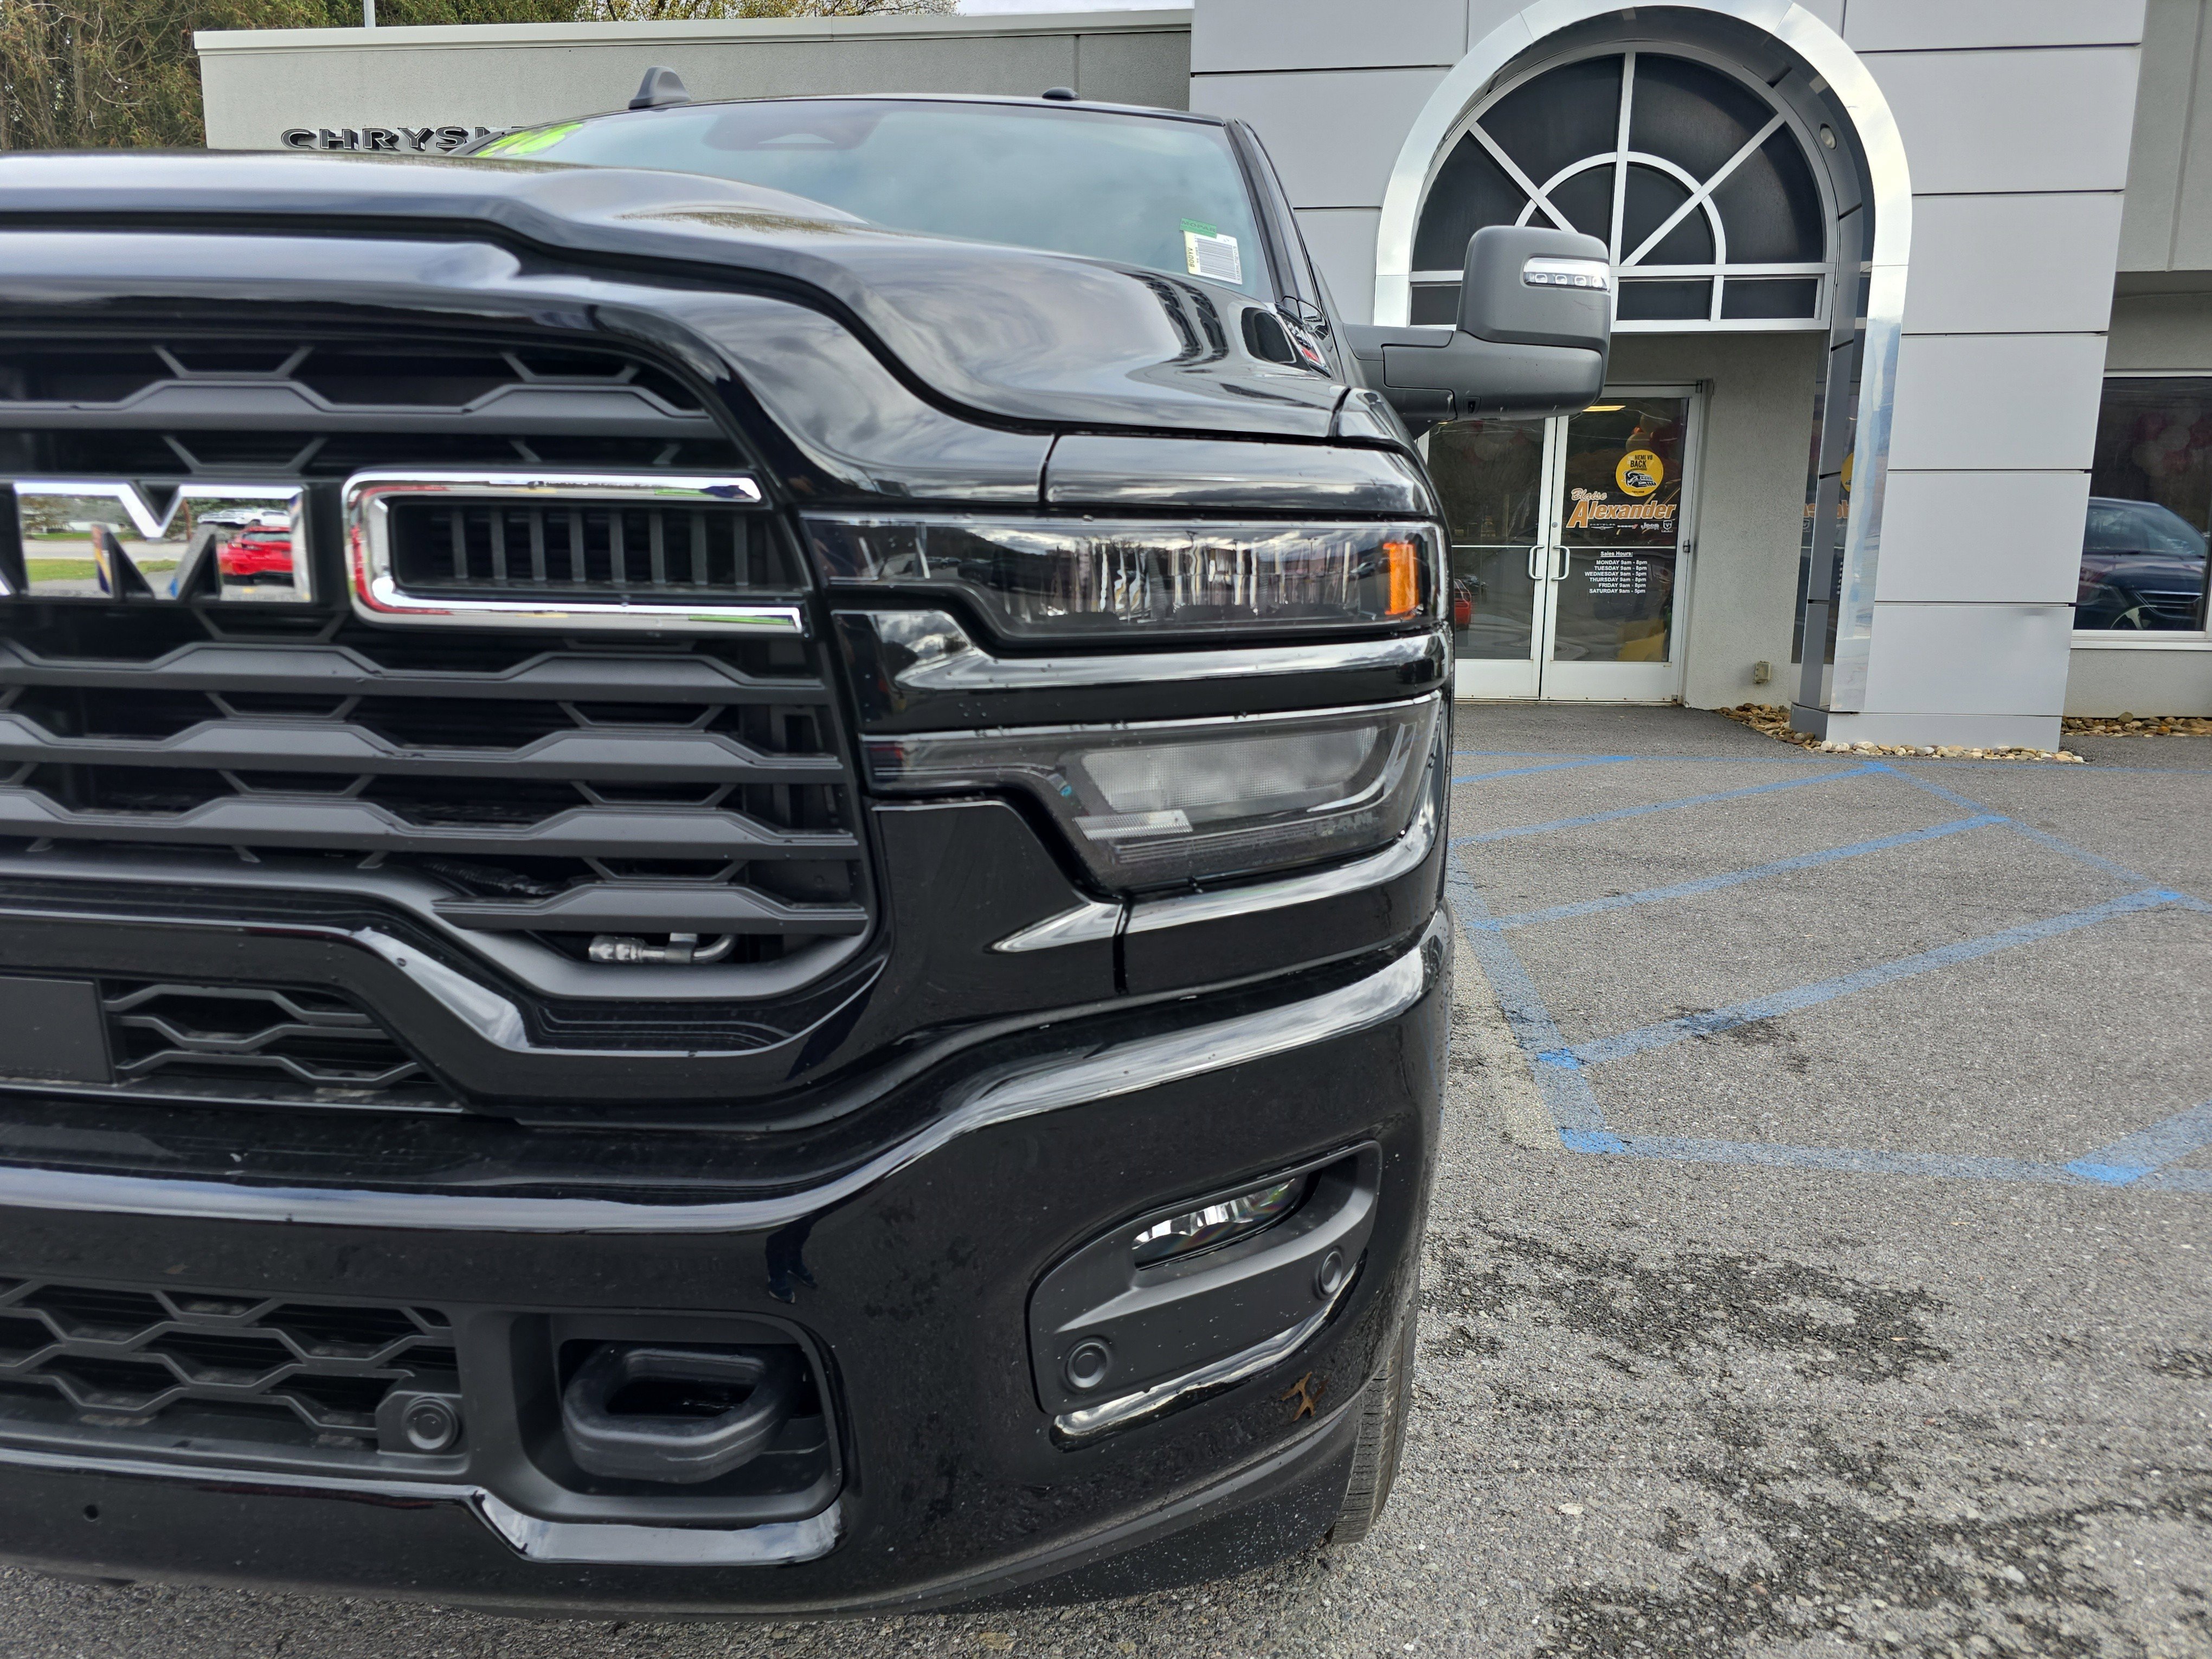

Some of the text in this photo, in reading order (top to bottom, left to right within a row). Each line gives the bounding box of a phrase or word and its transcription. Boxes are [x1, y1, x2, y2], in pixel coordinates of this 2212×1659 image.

[1181, 220, 1216, 233] MOPAR
[1571, 488, 1607, 500] Blaise
[1566, 500, 1677, 528] Alexander
[0, 483, 312, 602] M
